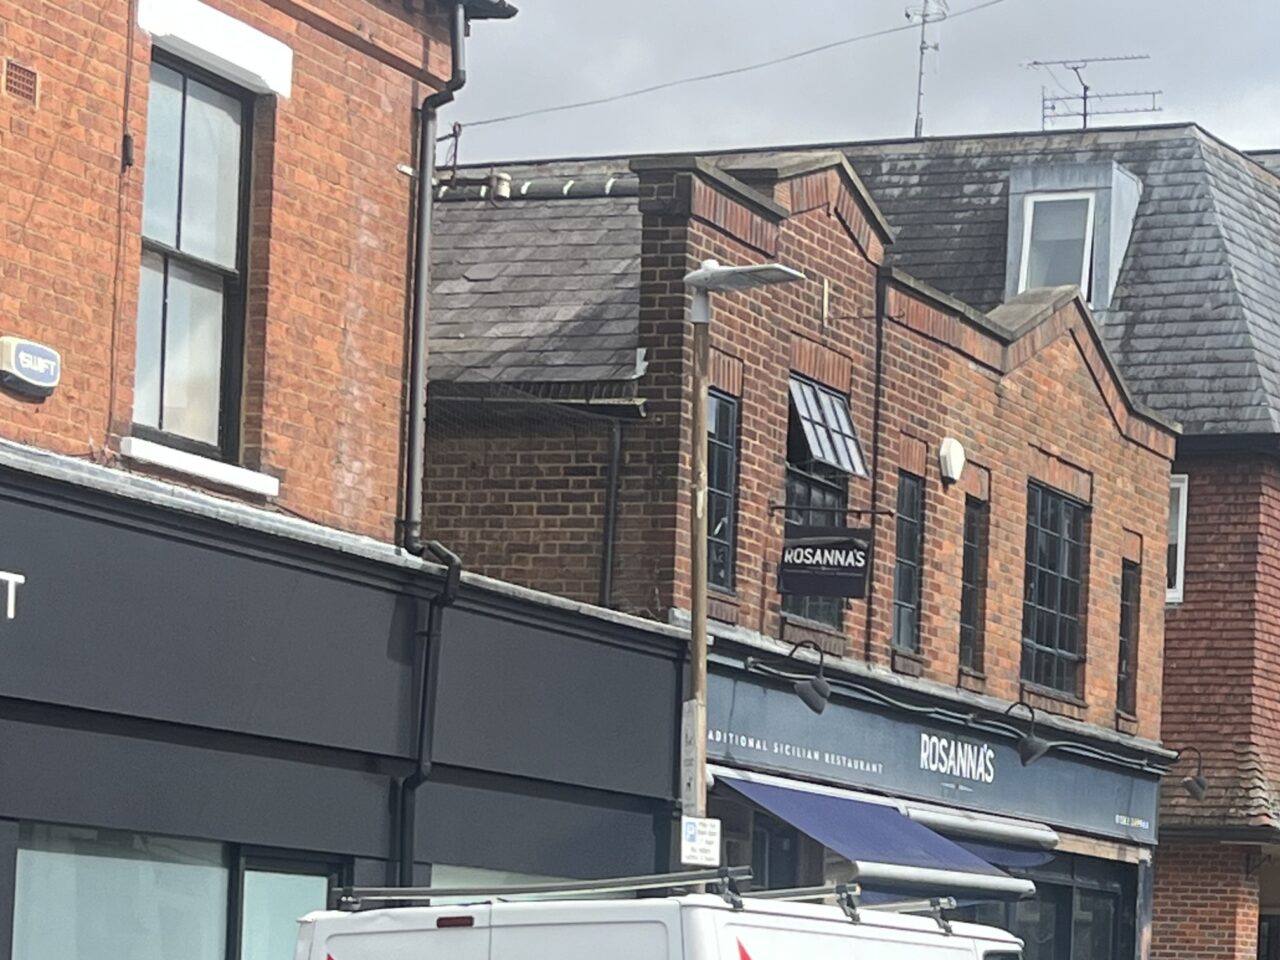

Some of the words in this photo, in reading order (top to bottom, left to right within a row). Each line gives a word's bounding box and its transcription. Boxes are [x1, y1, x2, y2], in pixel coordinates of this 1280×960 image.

[784, 547, 865, 568] ROSANNA'S
[707, 729, 769, 752] ADITIONAL
[773, 742, 820, 762] SICILIAN
[824, 752, 884, 775] RESTAURANT
[920, 732, 995, 783] ROSANNA'S
